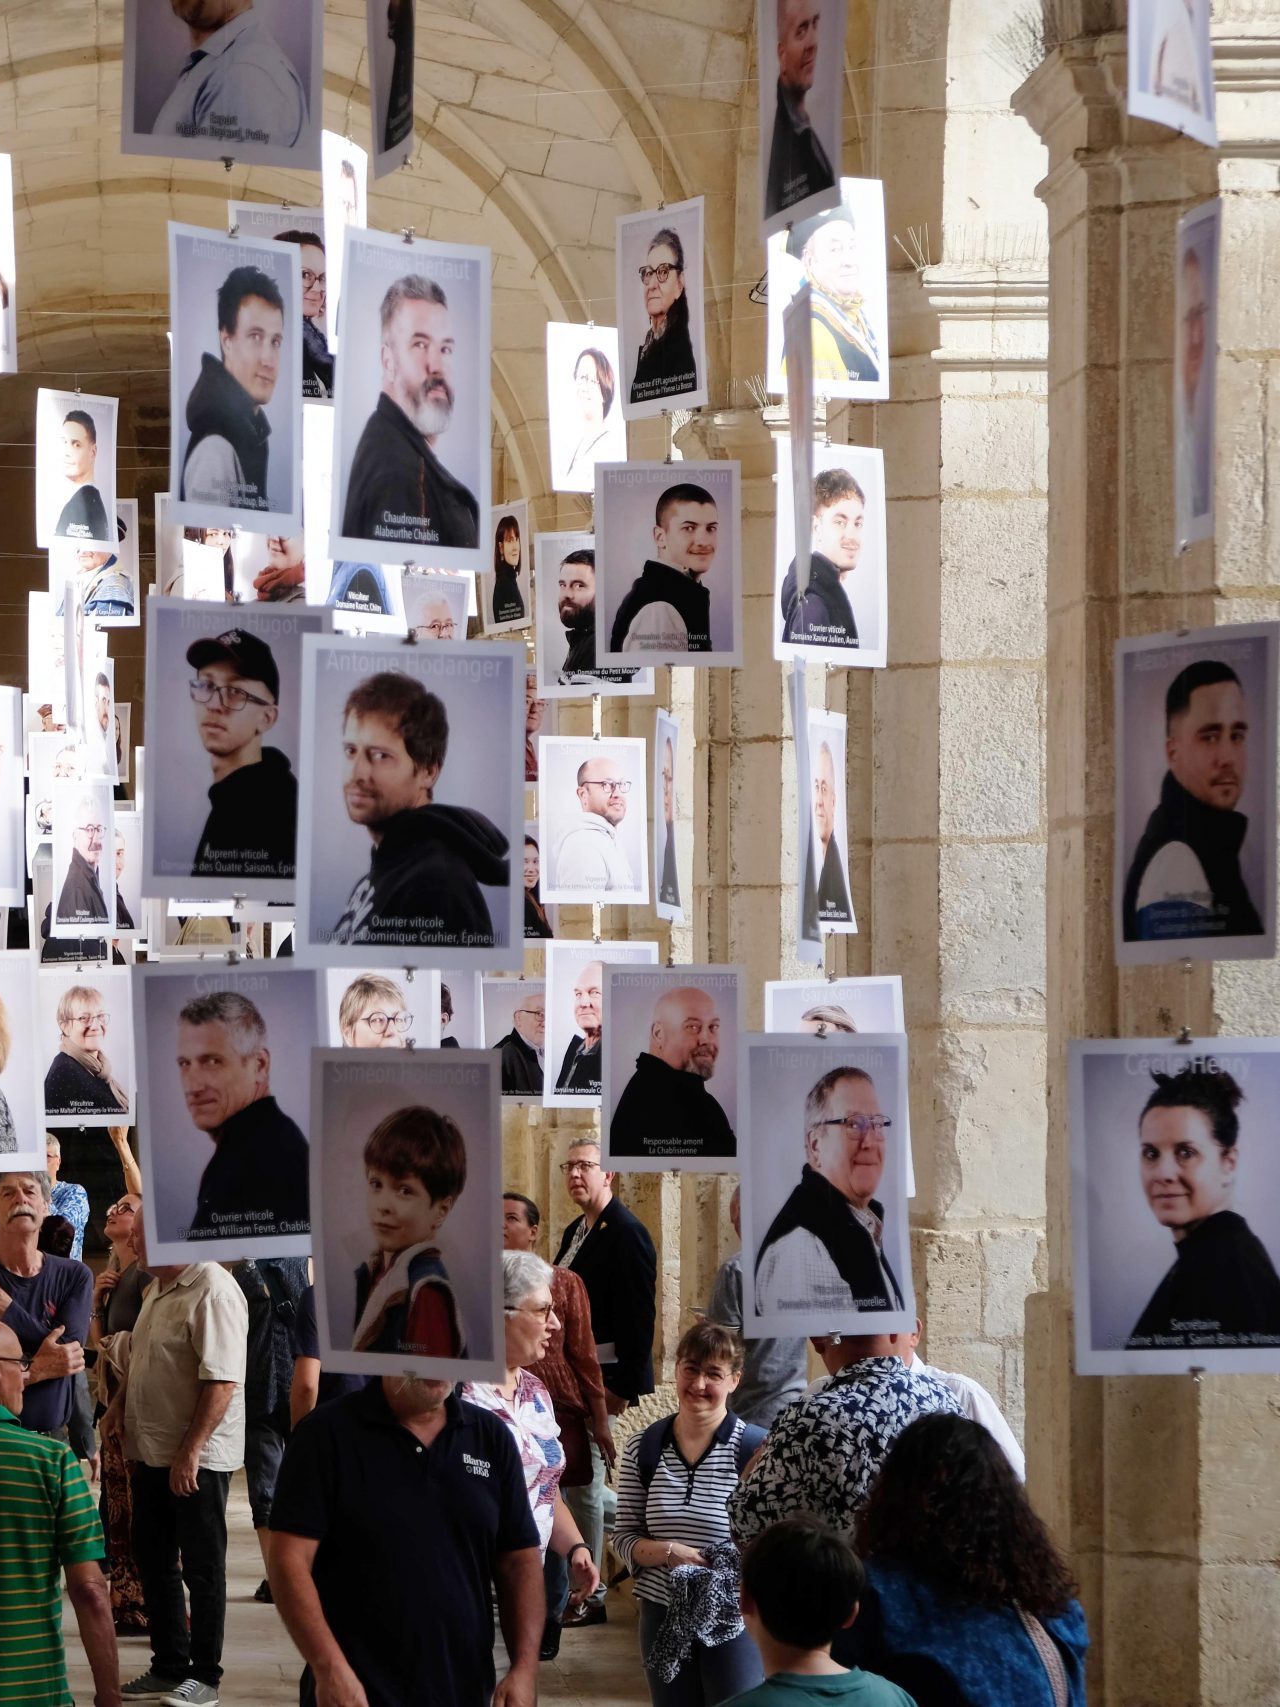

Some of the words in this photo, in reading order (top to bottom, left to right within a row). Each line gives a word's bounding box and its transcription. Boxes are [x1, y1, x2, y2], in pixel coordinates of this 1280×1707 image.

[192, 238, 235, 264] Antoine
[240, 244, 275, 273] Hugot
[608, 469, 642, 486] Hugo
[383, 511, 431, 526] Chaudronnier
[414, 528, 439, 542] Chablis
[247, 612, 299, 634] Hugot
[809, 624, 828, 633] Ouvrier
[829, 625, 847, 634] viticole
[791, 632, 813, 642] Domaine
[327, 650, 399, 673] Antoine
[407, 651, 504, 678] Hodanger
[204, 845, 239, 860] Apprenti
[241, 849, 269, 859] viticole
[199, 862, 213, 871] des
[215, 862, 242, 873] Quatre
[244, 862, 277, 874] Saisons,
[371, 914, 407, 927] Ouvrier
[409, 916, 445, 928] viticole
[363, 930, 417, 945] Dominique
[419, 932, 459, 945] Gruhier,
[677, 974, 738, 990] Lecompte
[801, 987, 828, 1004] Gary
[768, 1048, 818, 1072] Thierry
[823, 1048, 883, 1068] Hamelin
[1124, 1053, 1188, 1076] Cécile
[1192, 1054, 1251, 1079] Henry
[643, 1137, 682, 1147] Responsable
[649, 1146, 656, 1154] La
[657, 1146, 697, 1155] Chablisienne
[211, 1212, 242, 1224] Ouvrier
[244, 1211, 274, 1222] viticole
[219, 1223, 252, 1236] William
[254, 1222, 279, 1236] Fevre,
[280, 1220, 311, 1233] Chablis
[397, 1340, 428, 1352] Auxerre
[463, 1453, 490, 1469] Blanco
[473, 1466, 490, 1478] 1958
